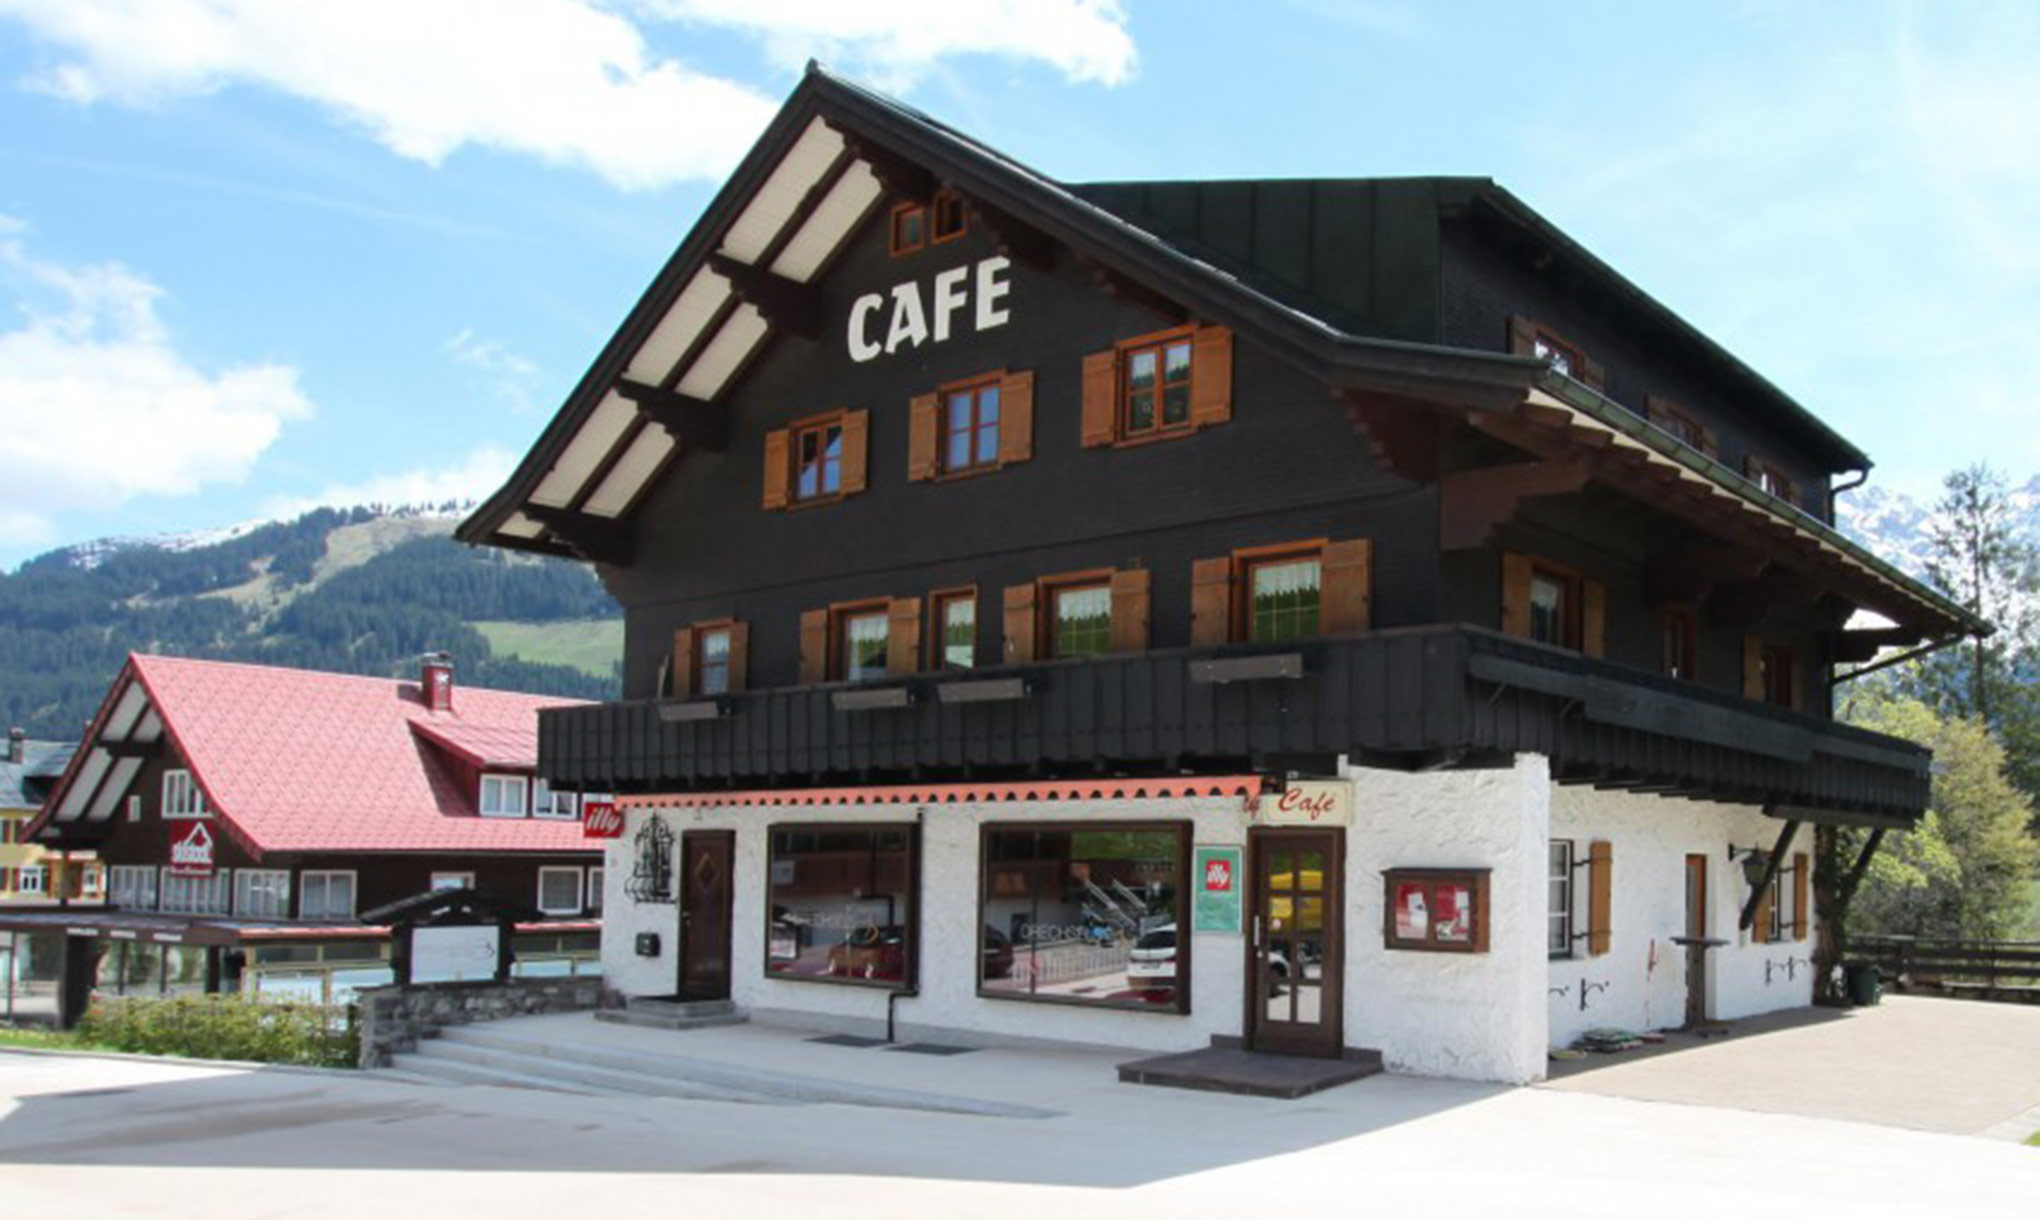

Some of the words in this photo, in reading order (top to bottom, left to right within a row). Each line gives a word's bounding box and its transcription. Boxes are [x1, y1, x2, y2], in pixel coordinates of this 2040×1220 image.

[847, 255, 1011, 363] CAFE
[586, 807, 620, 833] illy
[1278, 787, 1336, 820] Café
